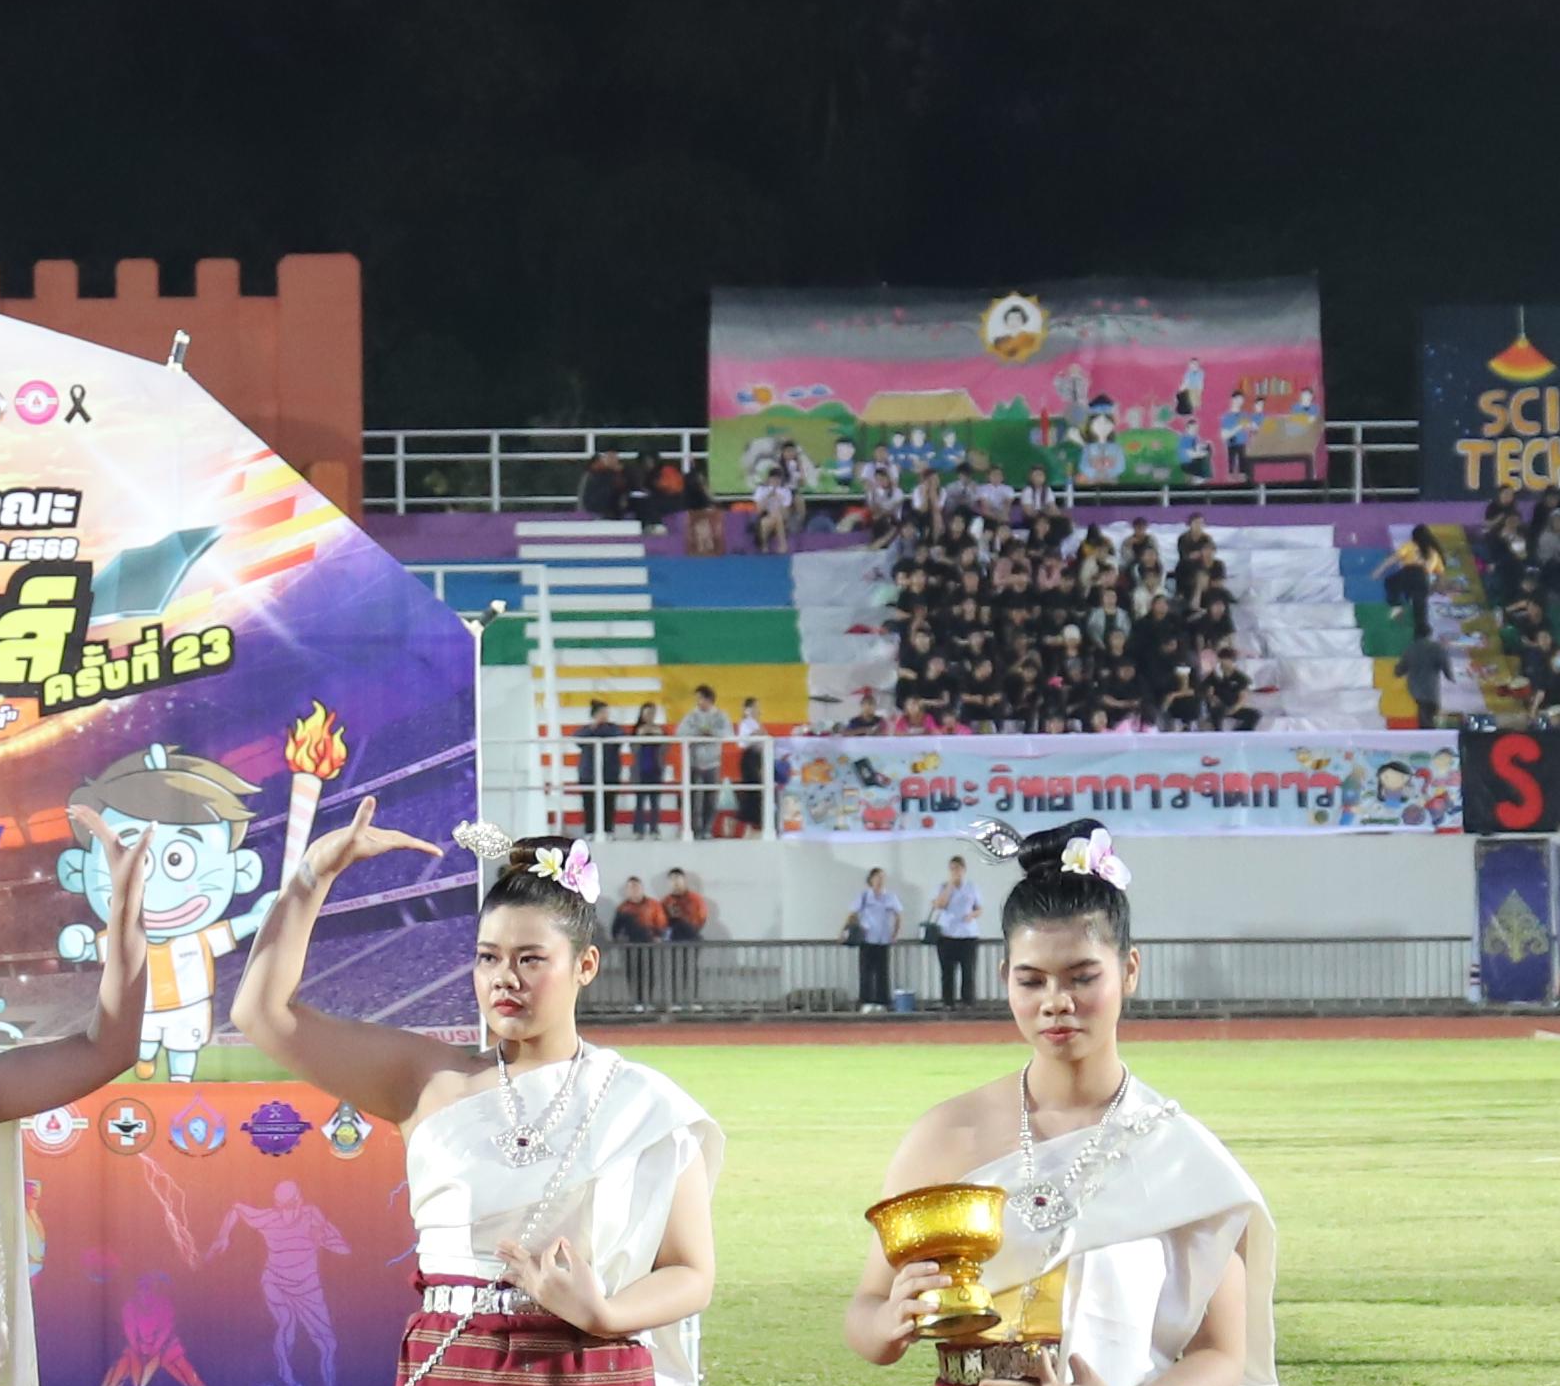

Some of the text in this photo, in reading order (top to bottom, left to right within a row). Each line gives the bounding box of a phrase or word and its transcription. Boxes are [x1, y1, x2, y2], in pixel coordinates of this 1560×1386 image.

[1479, 386, 1560, 437] SCI
[42, 627, 232, 708] ครั้งที่ 23
